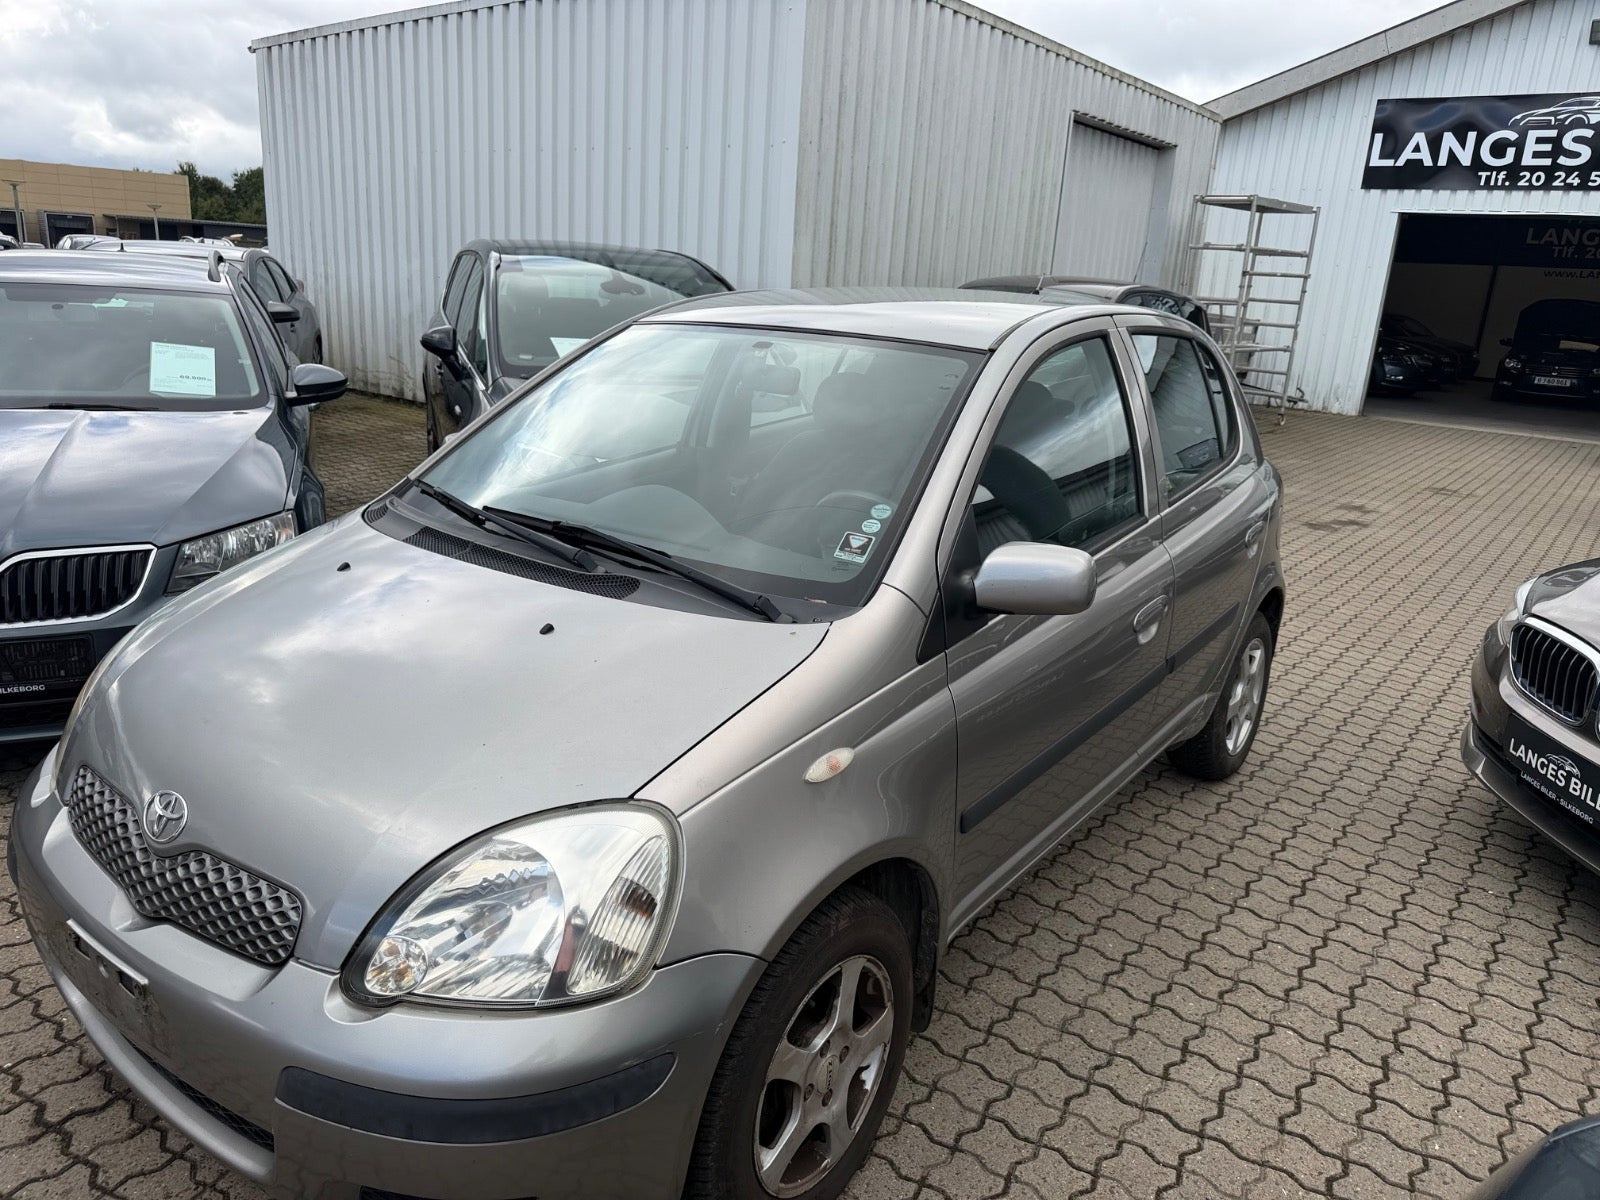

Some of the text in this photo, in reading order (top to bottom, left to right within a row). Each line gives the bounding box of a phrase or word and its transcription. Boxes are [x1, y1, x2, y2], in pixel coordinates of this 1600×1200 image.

[1368, 128, 1596, 167] LANGES
[1477, 171, 1510, 187] Tlf.
[1517, 171, 1546, 187] 20
[1552, 171, 1581, 187] 24
[1552, 246, 1578, 258] Tlf.
[1509, 738, 1567, 787] LANGES
[1520, 771, 1541, 789] LANGES
[1540, 785, 1557, 801] BILER
[1560, 799, 1594, 824] SILKEBORG
